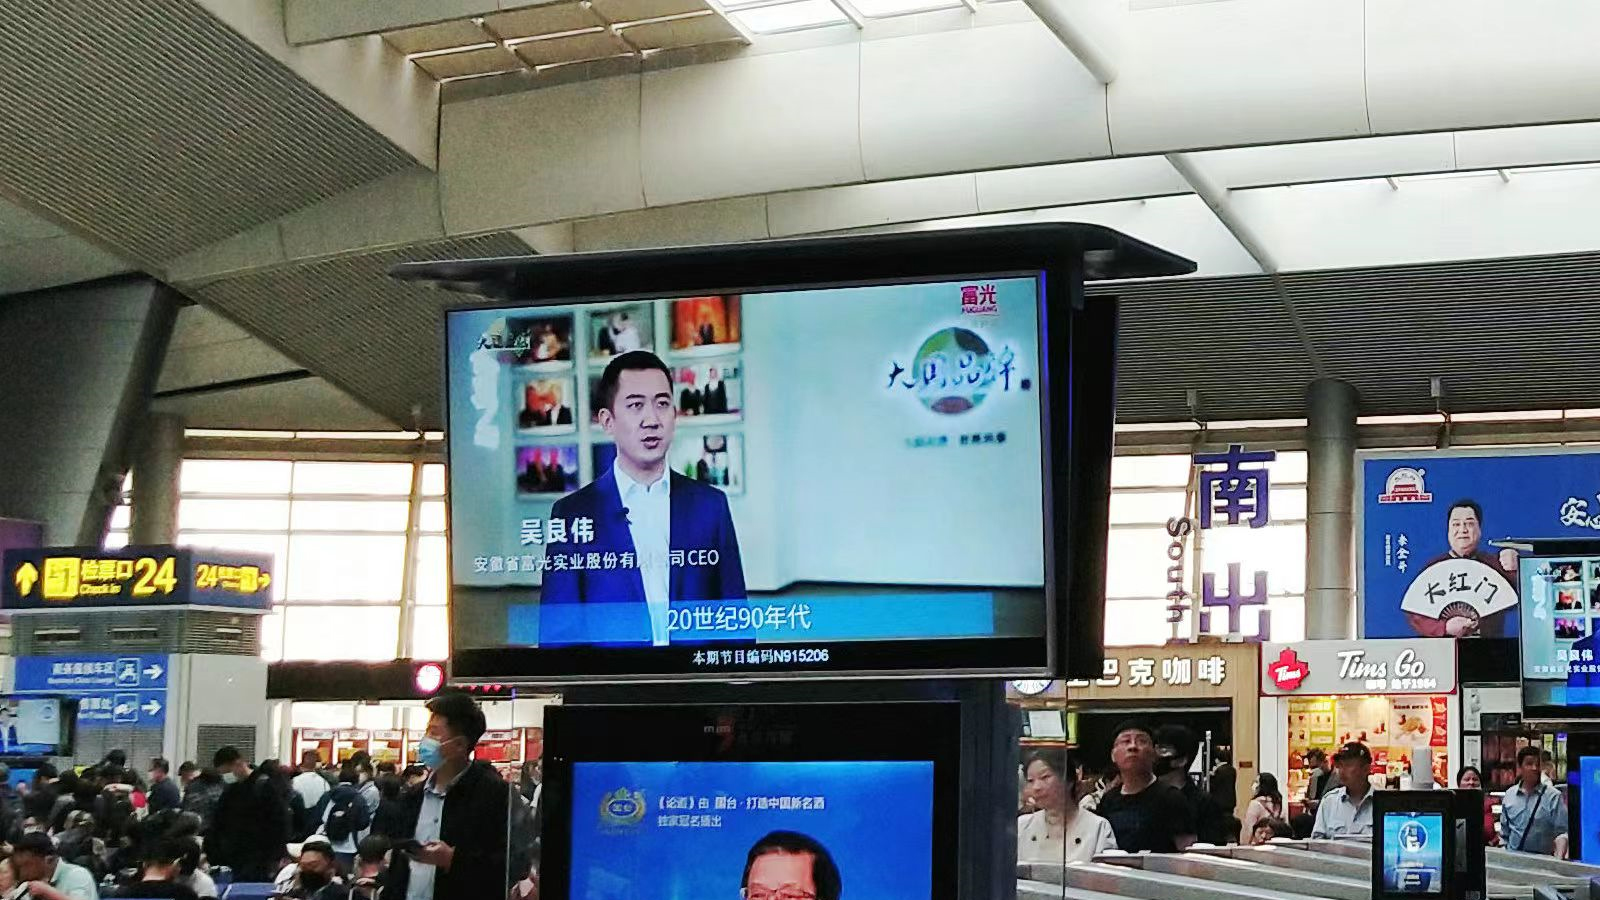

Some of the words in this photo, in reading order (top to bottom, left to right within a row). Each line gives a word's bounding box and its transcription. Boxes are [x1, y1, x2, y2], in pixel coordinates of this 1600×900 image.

[961, 284, 997, 305] 富光
[520, 517, 595, 546] 吴良伟
[474, 549, 720, 573] 安徽省富光实业股份有司CEO
[1166, 516, 1193, 623] South
[133, 556, 178, 596] 24
[195, 564, 219, 589] 24
[667, 603, 813, 632] 20世纪90年代
[692, 648, 830, 666] 本期节目编码N915206
[1337, 649, 1387, 679] Tims
[1394, 648, 1425, 677] Go
[1274, 665, 1301, 683] Tims
